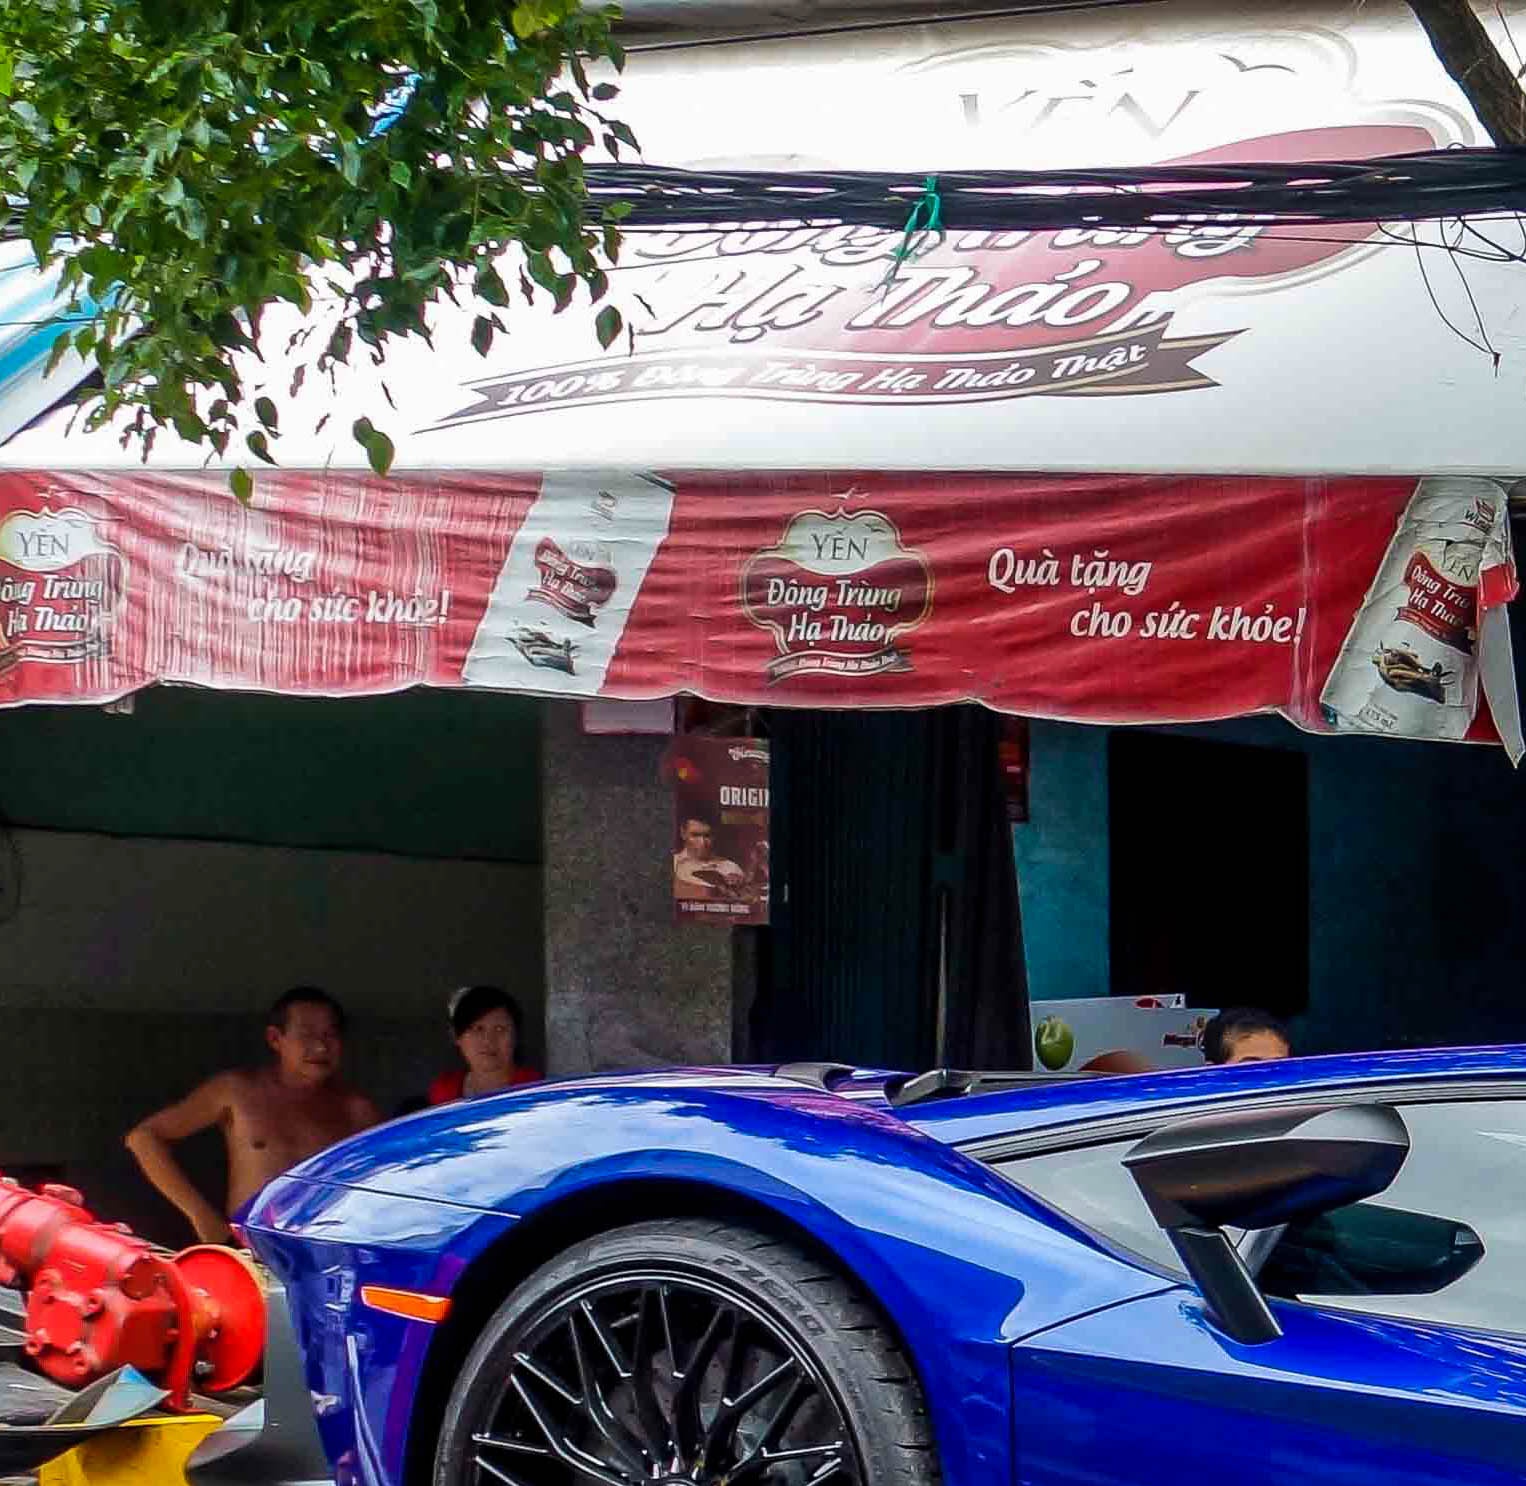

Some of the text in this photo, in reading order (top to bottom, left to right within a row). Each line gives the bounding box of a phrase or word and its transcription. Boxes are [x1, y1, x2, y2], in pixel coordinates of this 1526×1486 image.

[845, 258, 1133, 331] Thảo
[497, 370, 624, 405] 100%
[857, 368, 927, 393] Hạ
[932, 363, 1036, 391] Thảo
[1050, 344, 1149, 380] Thật
[811, 527, 870, 561] YẾN
[988, 547, 1152, 596] Quà tặng
[0, 577, 37, 606] ông
[766, 577, 902, 613] Đông Trùng
[787, 611, 885, 647] Hạ Thảo
[1069, 601, 1306, 643] cho sức khỏe!
